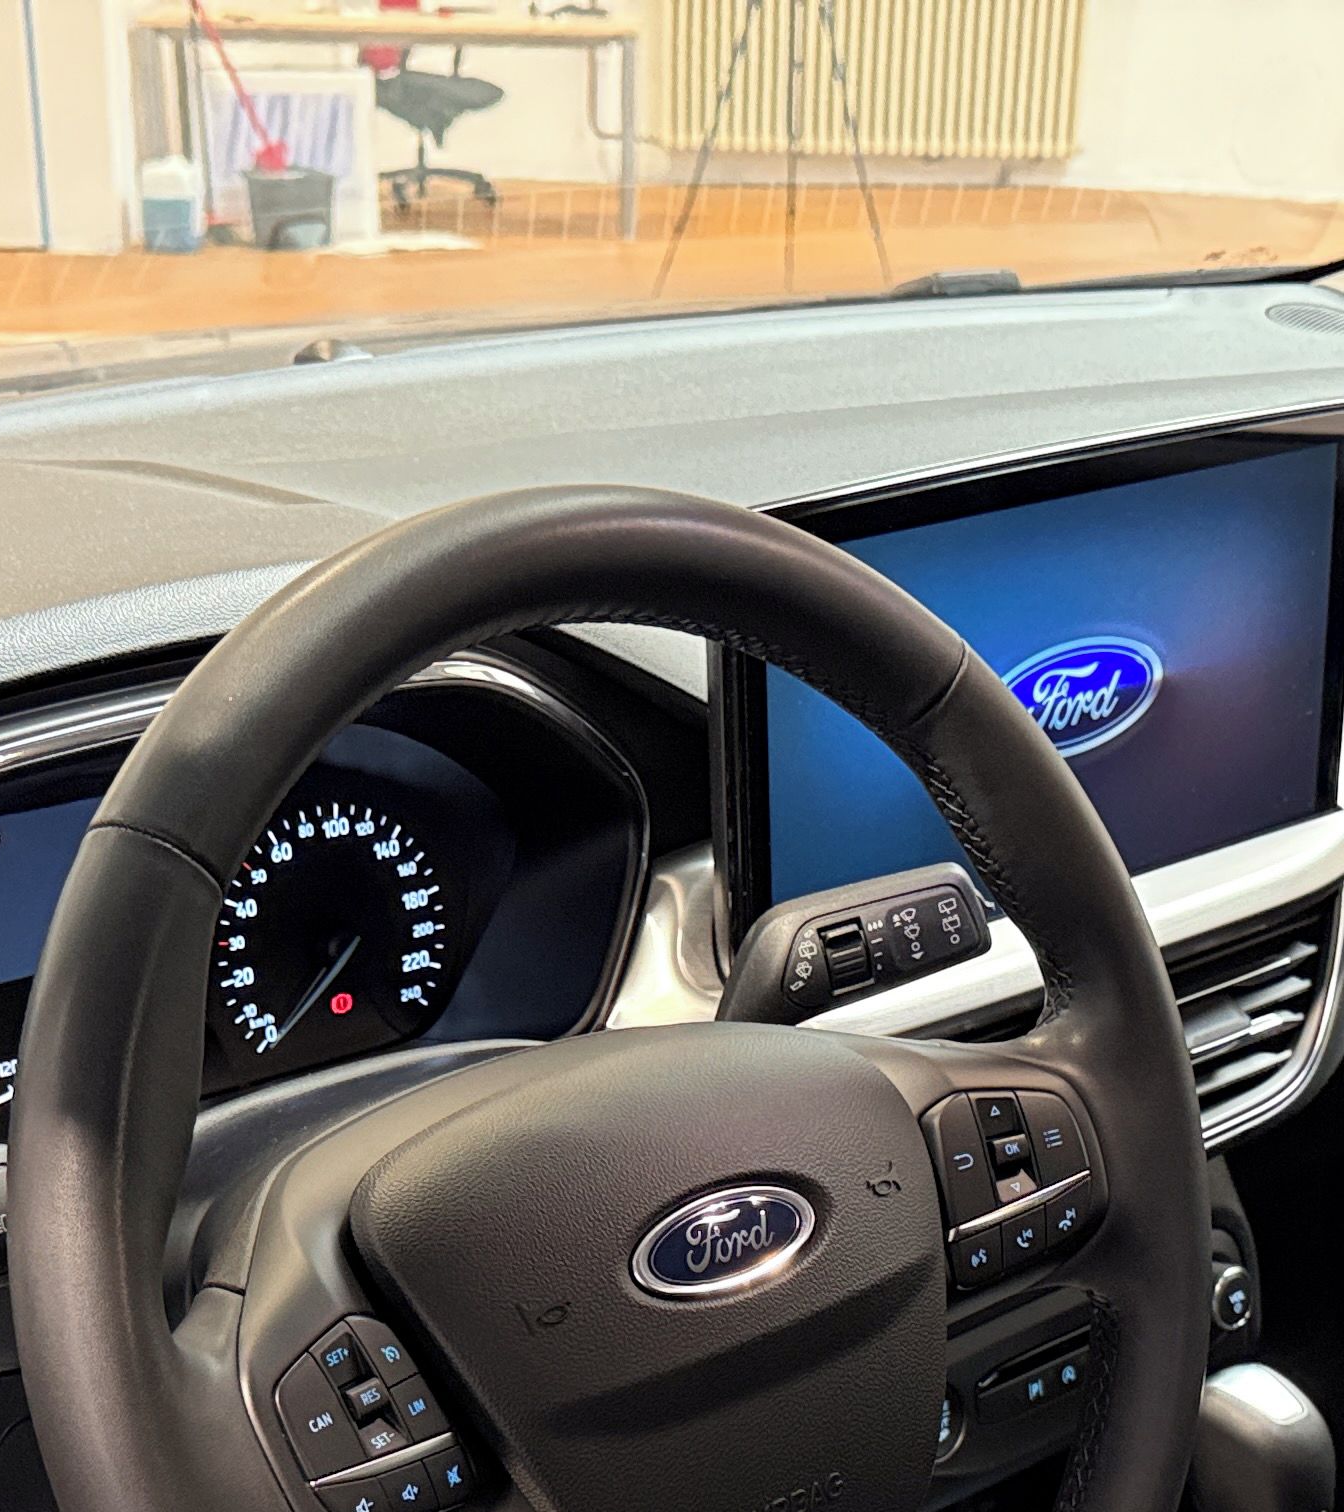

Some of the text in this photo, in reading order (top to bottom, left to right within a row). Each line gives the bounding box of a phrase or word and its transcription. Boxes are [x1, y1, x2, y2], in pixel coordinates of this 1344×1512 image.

[1028, 661, 1122, 731] Ford
[322, 817, 350, 839] 100
[271, 842, 293, 863] 60
[373, 839, 400, 860] 140
[251, 868, 268, 885] 50
[397, 861, 417, 877] 160
[236, 898, 258, 919] 40
[402, 888, 429, 910] 180
[412, 921, 435, 938] 200
[228, 936, 246, 951] 30
[401, 950, 430, 972] 220
[233, 966, 255, 988] 20
[400, 985, 422, 1002] 240
[264, 1024, 277, 1043] 0
[1004, 1142, 1021, 1155] OK
[685, 1208, 776, 1273] Ford
[359, 1387, 381, 1406] RES
[407, 1398, 426, 1417] LIM
[308, 1411, 333, 1433] CAN
